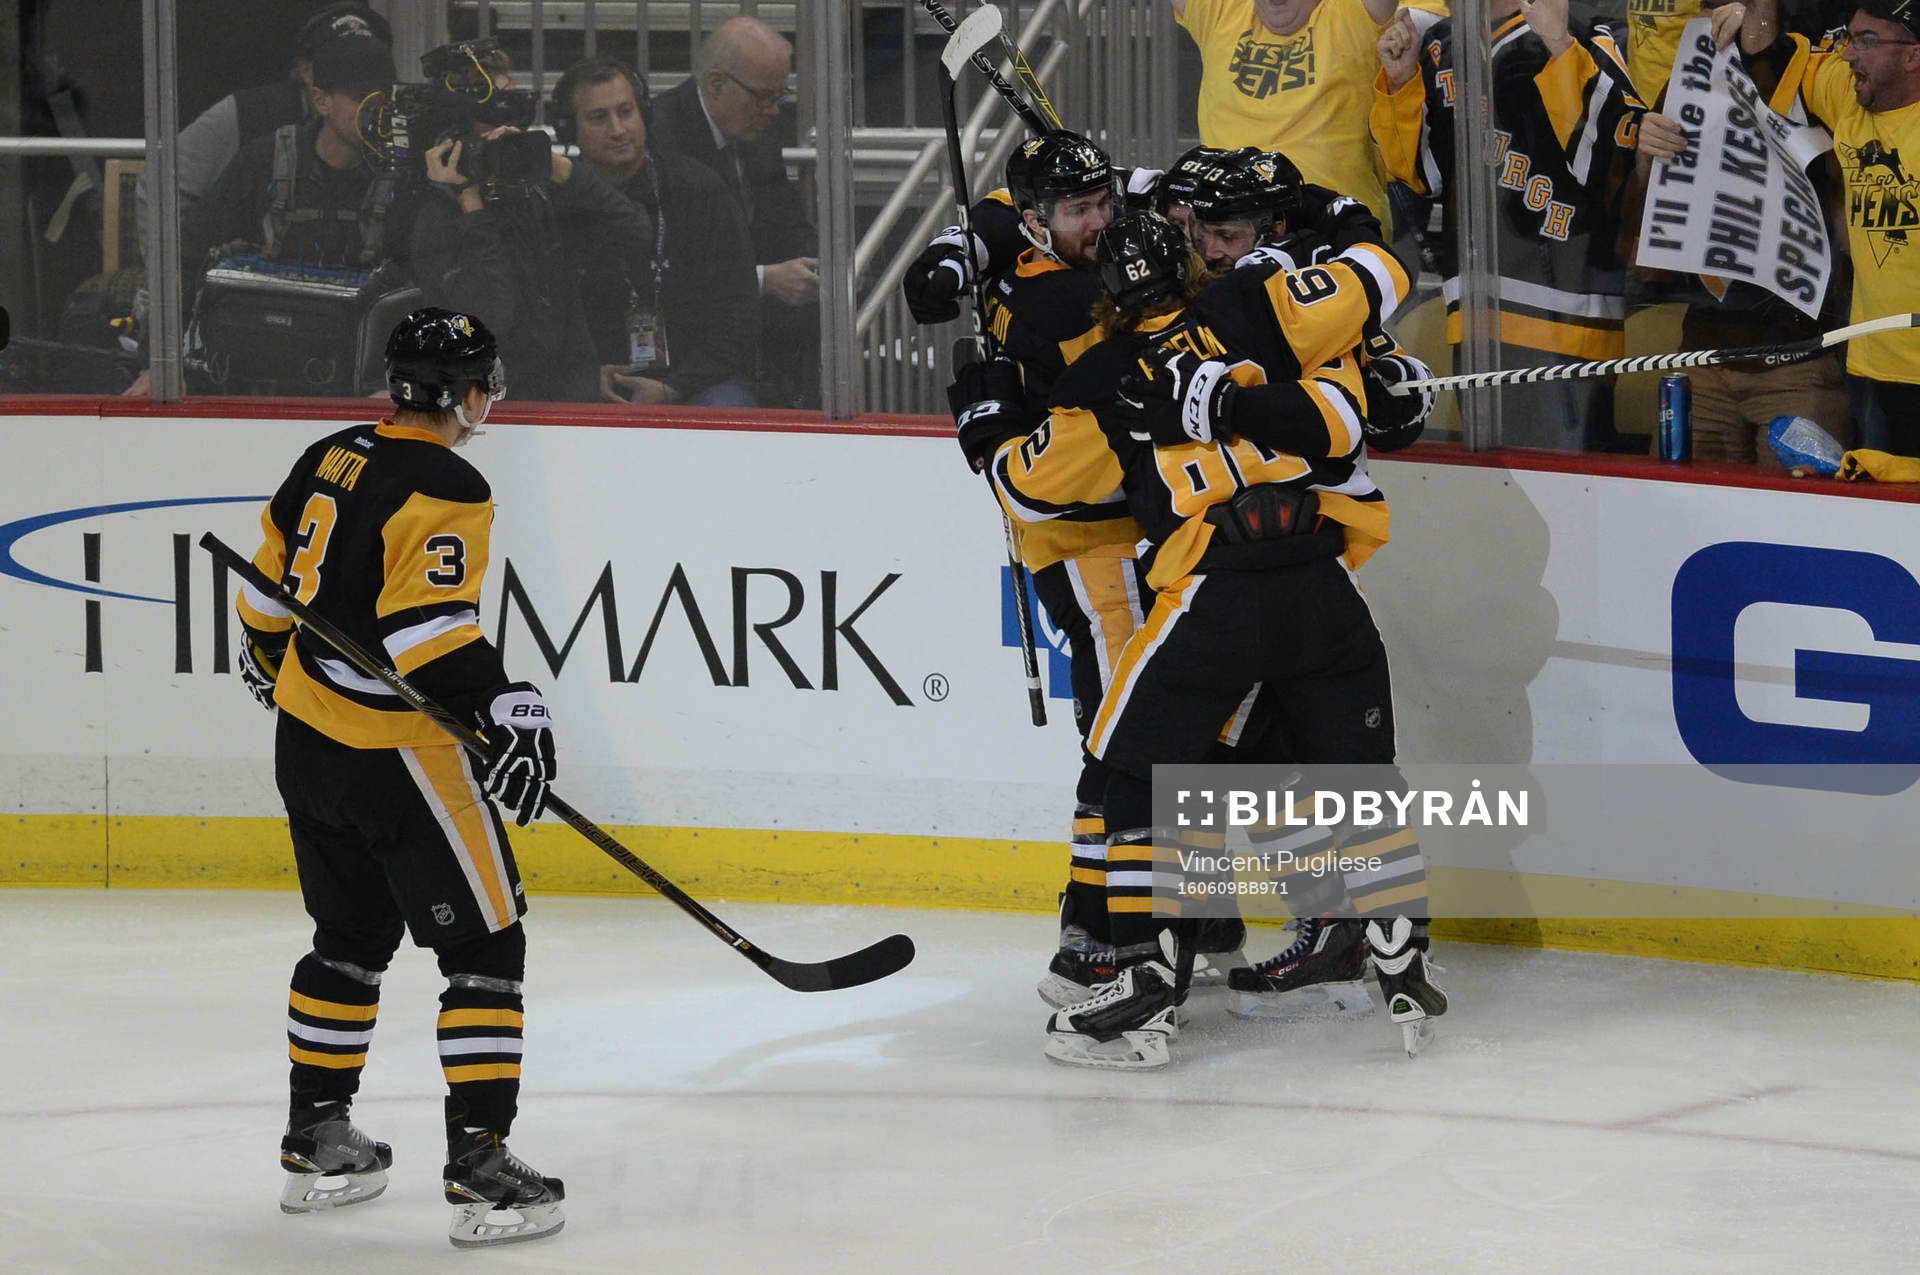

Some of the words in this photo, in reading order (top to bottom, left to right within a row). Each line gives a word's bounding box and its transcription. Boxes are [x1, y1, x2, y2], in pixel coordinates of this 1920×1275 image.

[924, 0, 1030, 114] EASON
[1681, 34, 1717, 92] the
[1082, 168, 1107, 182] CCM
[1203, 167, 1225, 182] 13
[1704, 190, 1766, 276] PHIL
[1125, 258, 1151, 281] 62
[402, 382, 412, 400] 3
[1189, 373, 1209, 438] CCM
[281, 492, 338, 607] 3
[424, 533, 466, 588] 3
[83, 532, 915, 707] HIMARK
